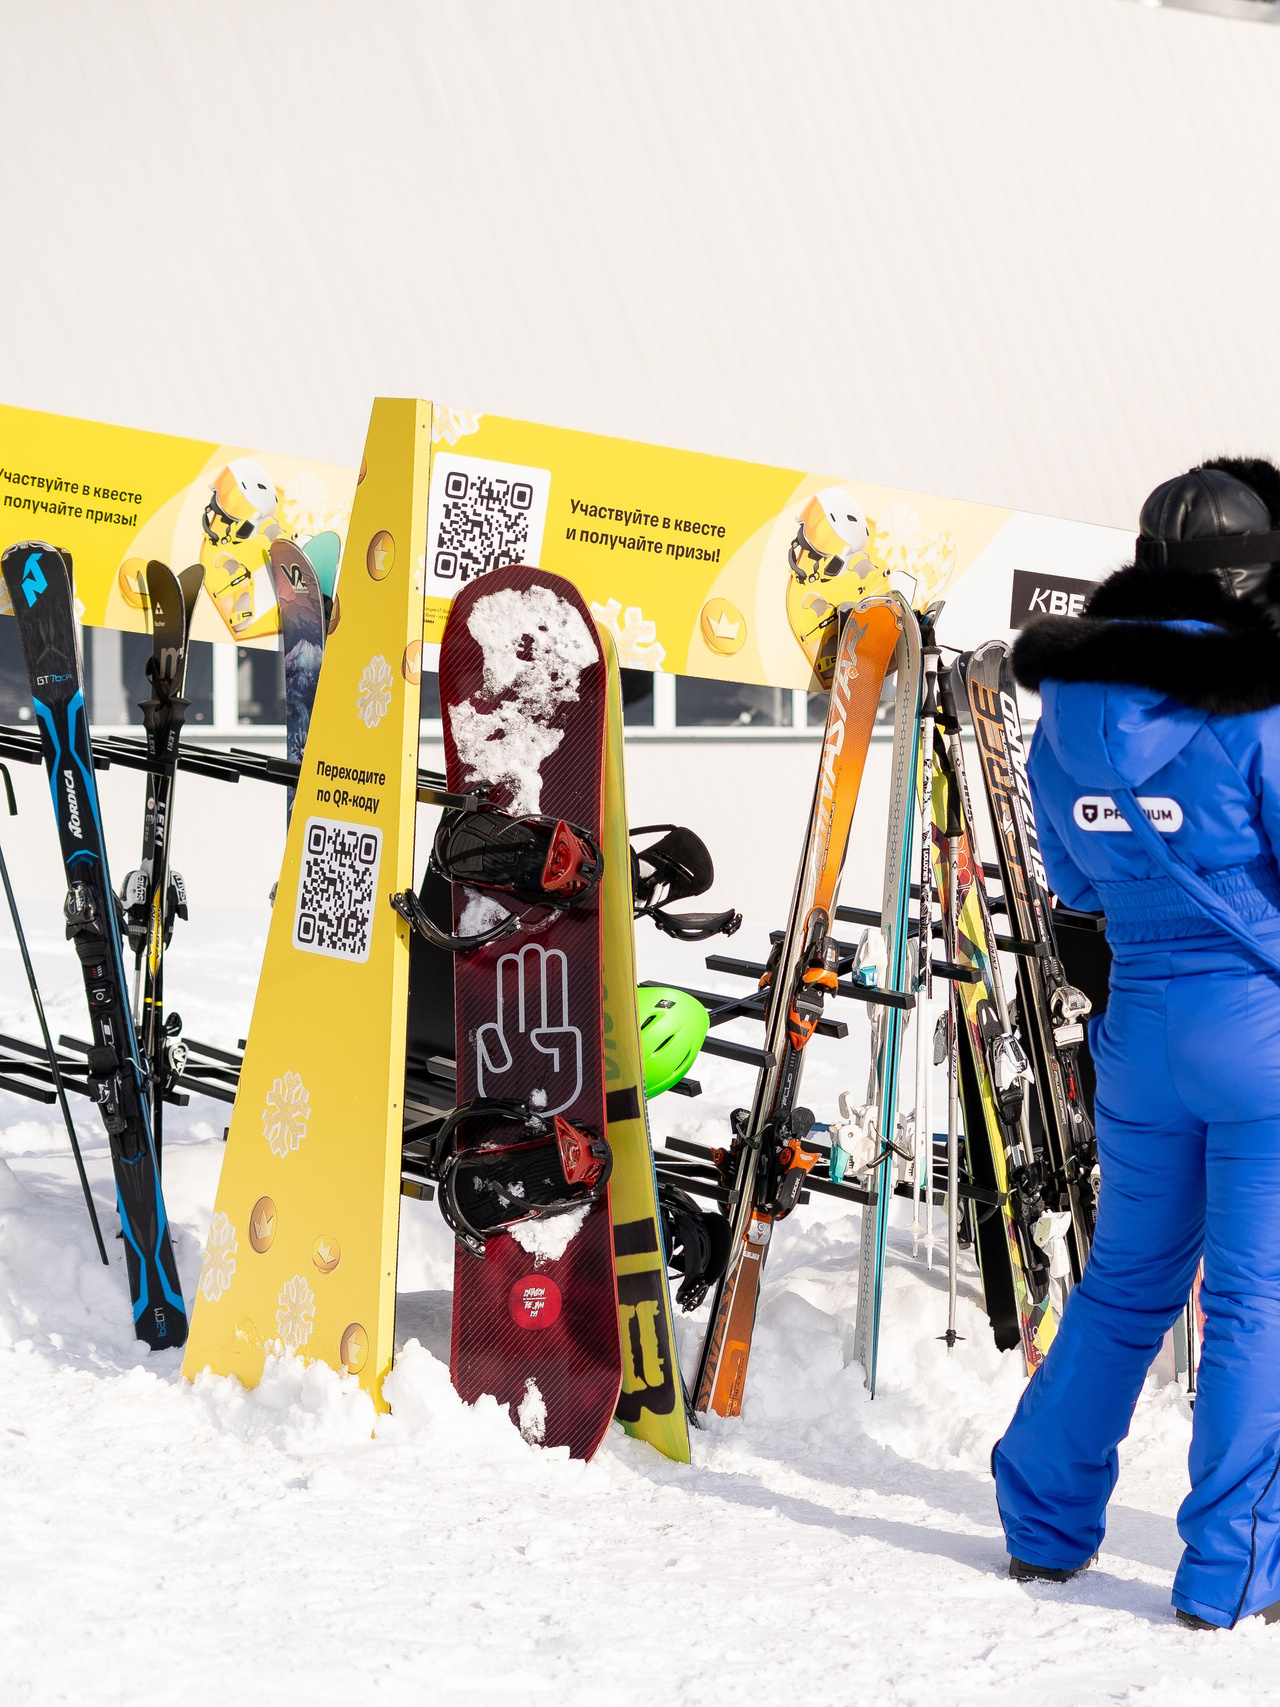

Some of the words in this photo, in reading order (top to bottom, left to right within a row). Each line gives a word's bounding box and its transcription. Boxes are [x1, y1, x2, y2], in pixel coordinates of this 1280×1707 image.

[82, 484, 90, 496] в
[93, 486, 143, 505] квесте
[4, 495, 83, 518] получайте
[85, 508, 138, 527] призы!
[570, 498, 660, 530] Участвуйте
[663, 517, 671, 529] в
[674, 519, 726, 539] квесте
[566, 527, 577, 541] и
[579, 529, 663, 554] получайте
[665, 543, 721, 563] призы!
[316, 760, 386, 786] Переходите
[316, 789, 331, 803] по
[332, 789, 380, 815] QR-коду
[1103, 808, 1173, 820] PRIUM
[922, 850, 930, 883] salomon
